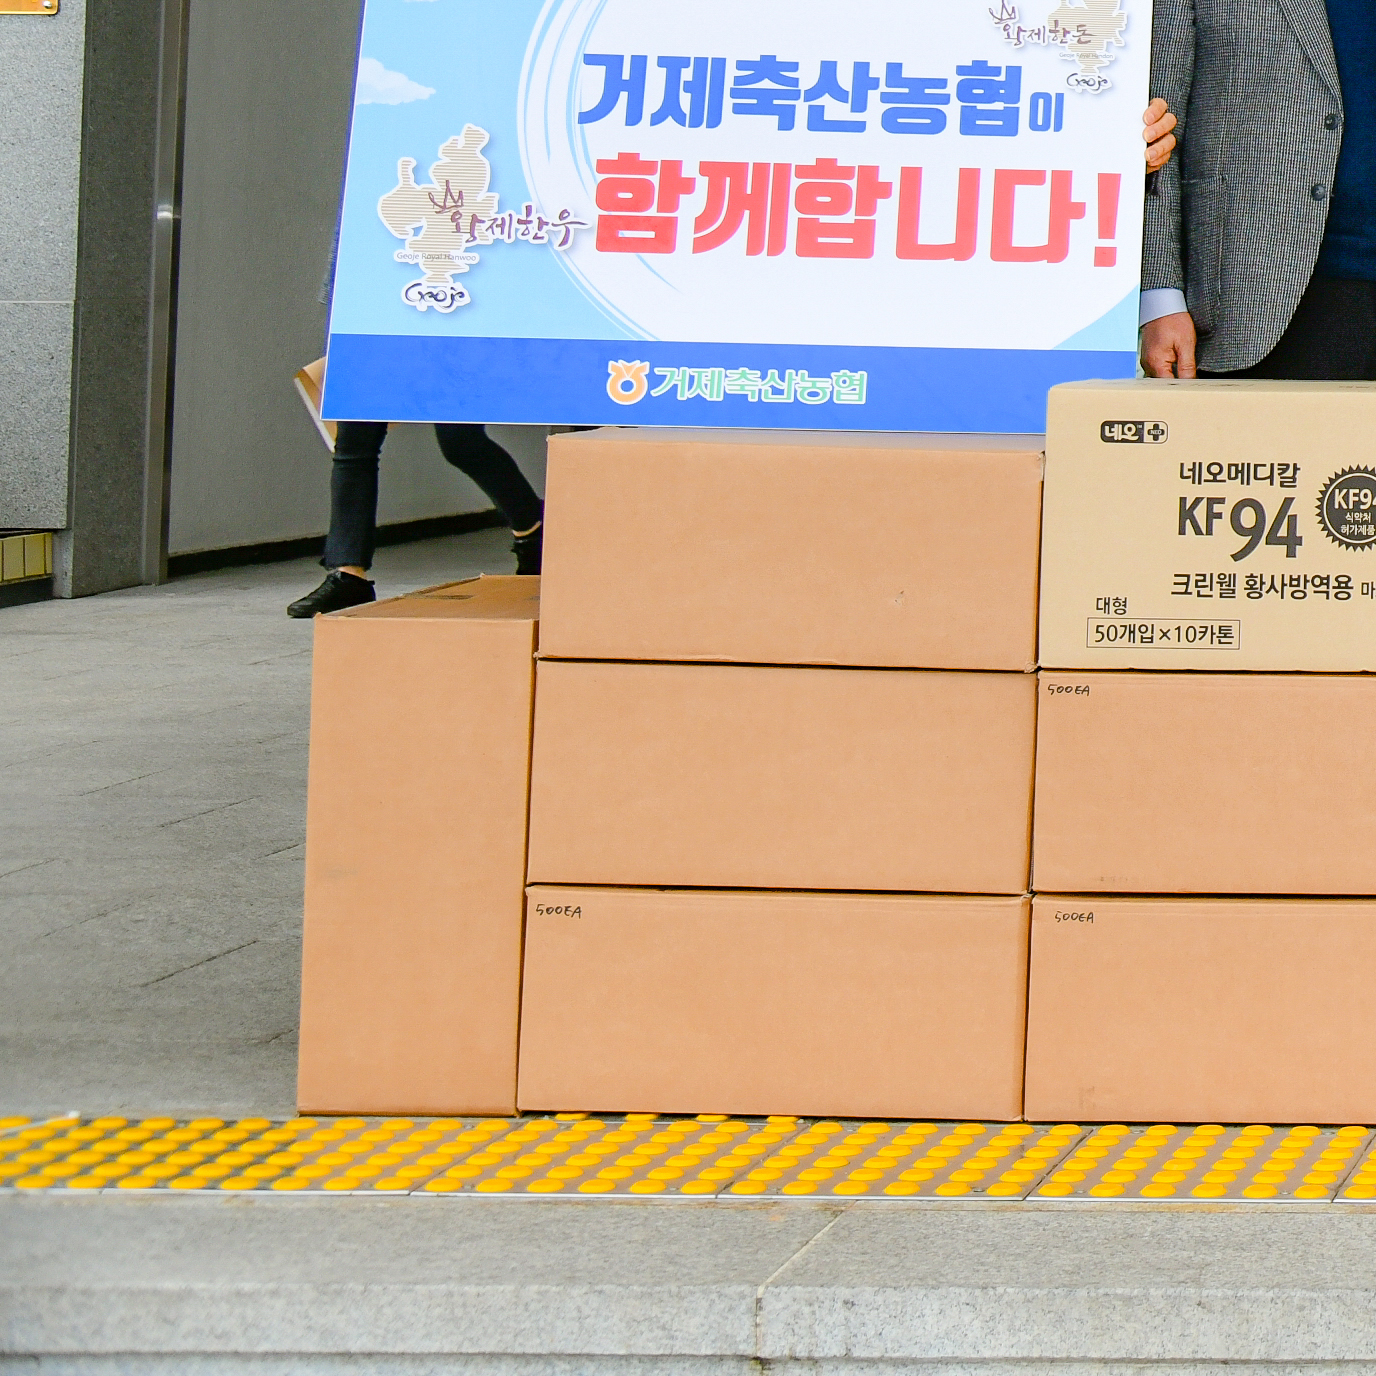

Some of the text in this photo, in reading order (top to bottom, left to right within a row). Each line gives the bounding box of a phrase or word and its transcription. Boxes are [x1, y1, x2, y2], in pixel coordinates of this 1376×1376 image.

[578, 53, 1064, 139] 거제축산농협이
[595, 152, 1121, 267] 함께합니다!
[397, 252, 419, 261] Geoje
[650, 366, 868, 405] 거제축산농협
[1104, 423, 1140, 441] 네오
[1180, 462, 1300, 488] 네오메디칼
[1344, 511, 1372, 524] 식약처
[1340, 523, 1376, 537] 허가제품
[1171, 573, 1236, 598] 크린웰
[1244, 573, 1353, 600] 황사방역용
[1096, 597, 1127, 615] 대형
[1047, 683, 1091, 697] 500EA
[535, 903, 583, 920] 500EA
[1054, 910, 1095, 924] 500EA
